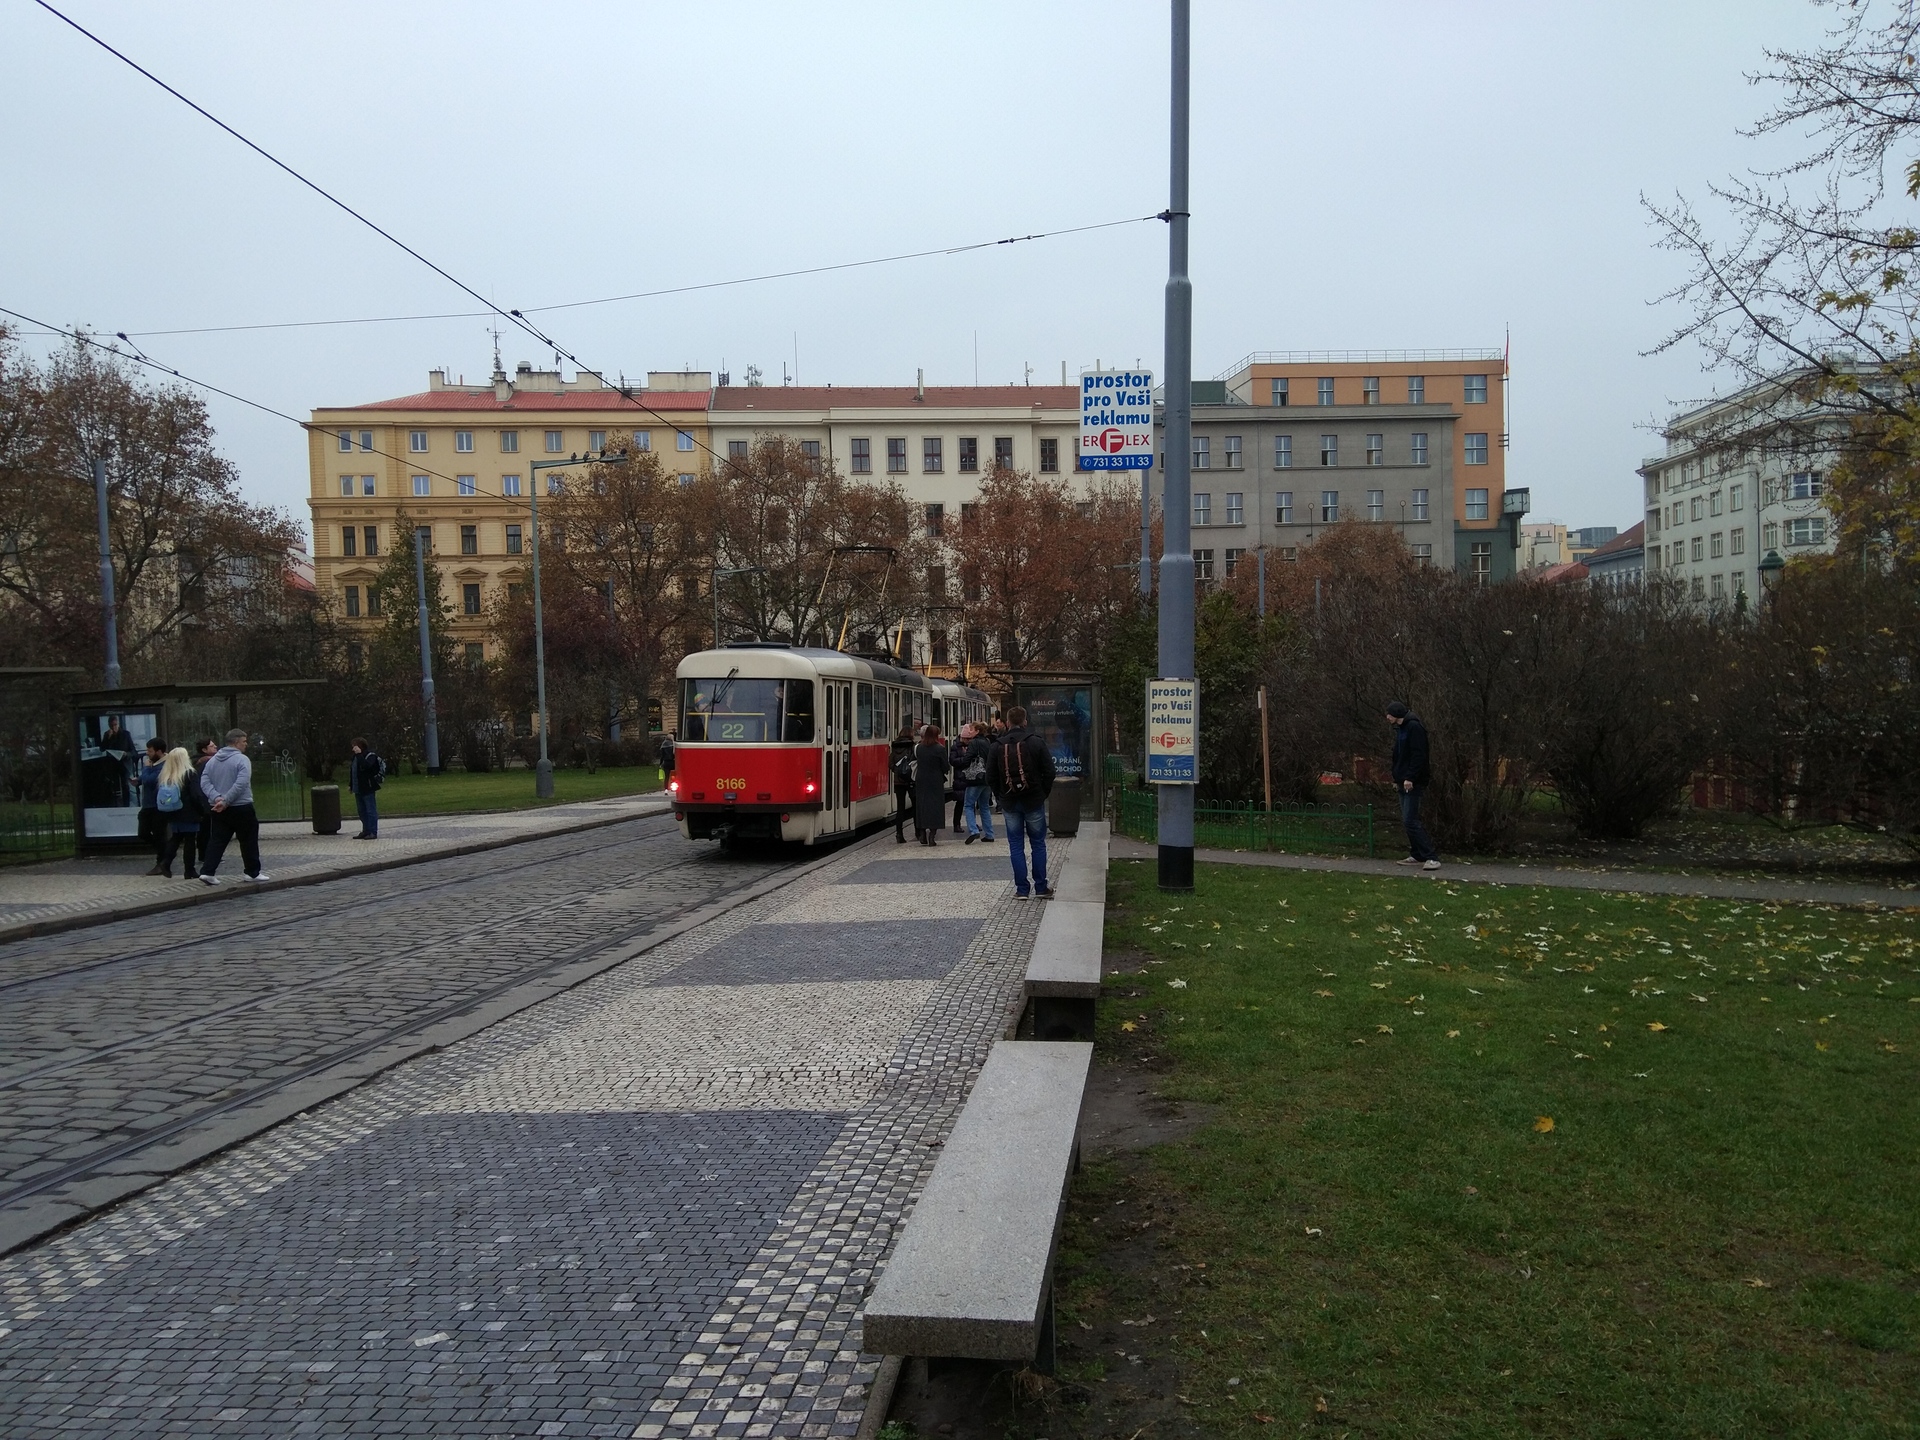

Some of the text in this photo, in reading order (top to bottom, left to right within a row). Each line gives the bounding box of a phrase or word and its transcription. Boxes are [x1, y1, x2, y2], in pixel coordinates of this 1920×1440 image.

[1083, 372, 1151, 393] prostor
[1083, 389, 1151, 411] pro Vaši
[1083, 409, 1150, 426] reklamu
[1093, 456, 1149, 467] 731 33 11 33
[1151, 687, 1193, 699] prostor
[1151, 700, 1192, 712] pro Vaši
[1151, 714, 1192, 725] reklamu
[721, 723, 744, 739] 22
[1151, 768, 1162, 776] 731
[1163, 768, 1173, 777] 33
[1182, 769, 1192, 777] 33
[716, 778, 746, 790] 8166
